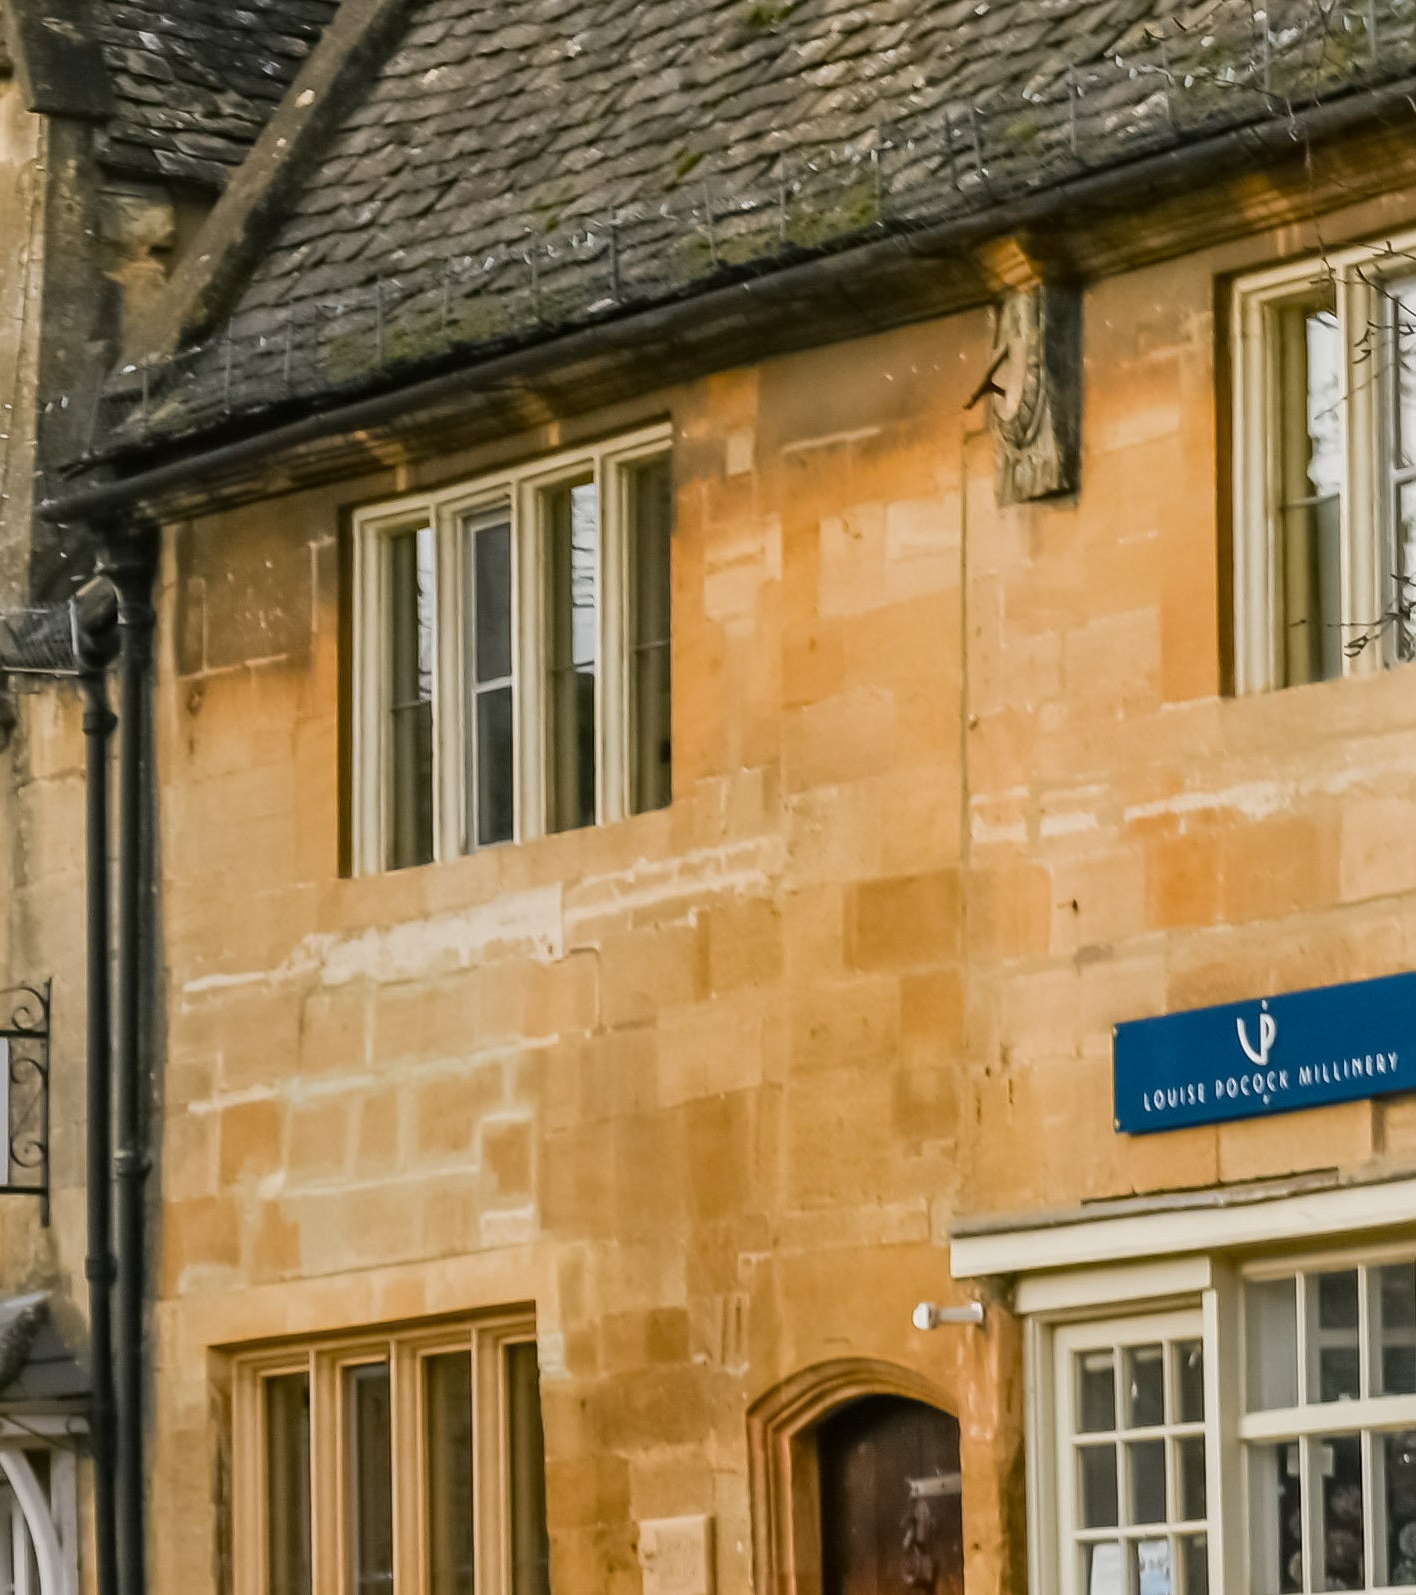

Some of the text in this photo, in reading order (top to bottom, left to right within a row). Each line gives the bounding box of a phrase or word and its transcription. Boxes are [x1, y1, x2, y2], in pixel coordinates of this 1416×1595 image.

[1143, 1051, 1399, 1113] LOUISE POCOCK MILLINERY
